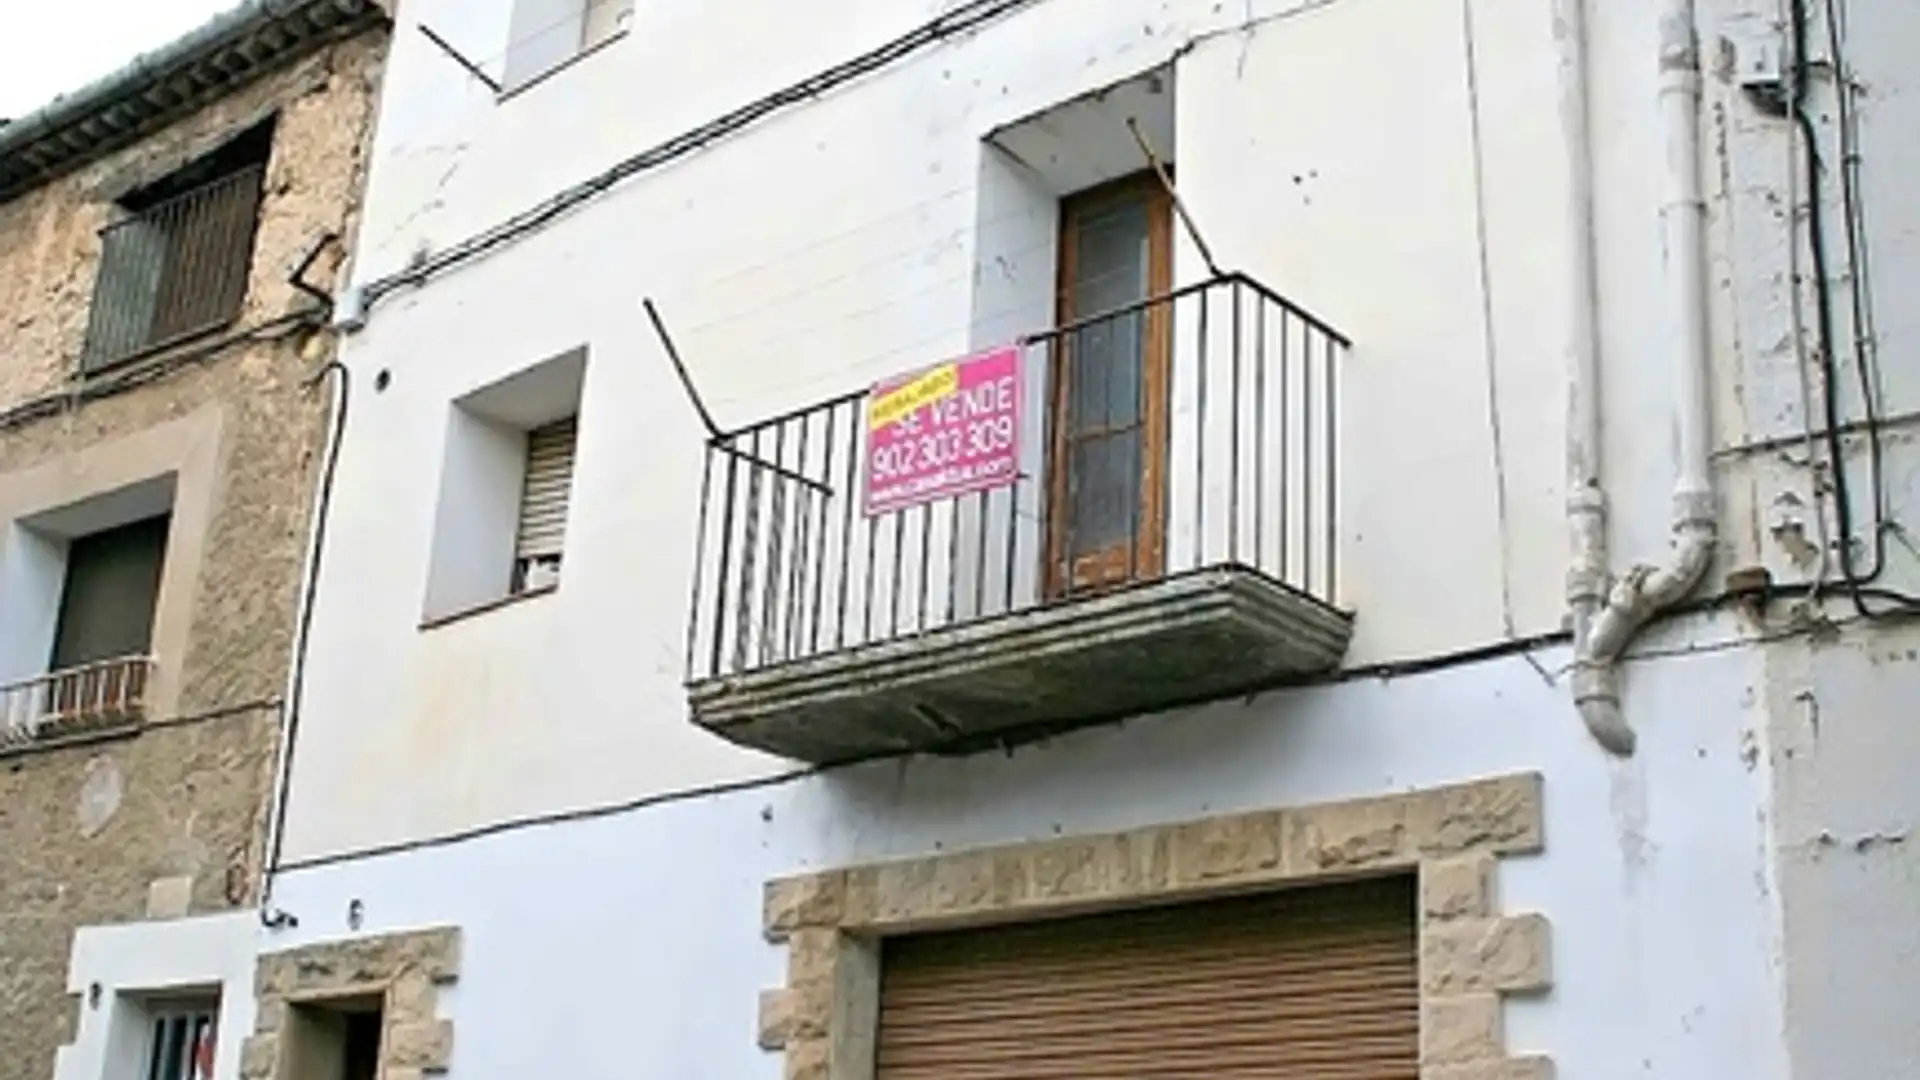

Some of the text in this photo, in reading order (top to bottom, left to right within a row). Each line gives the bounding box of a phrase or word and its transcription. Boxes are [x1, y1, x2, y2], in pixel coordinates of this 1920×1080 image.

[931, 376, 1013, 426] VENDE
[873, 416, 1013, 482] 902 303 309
